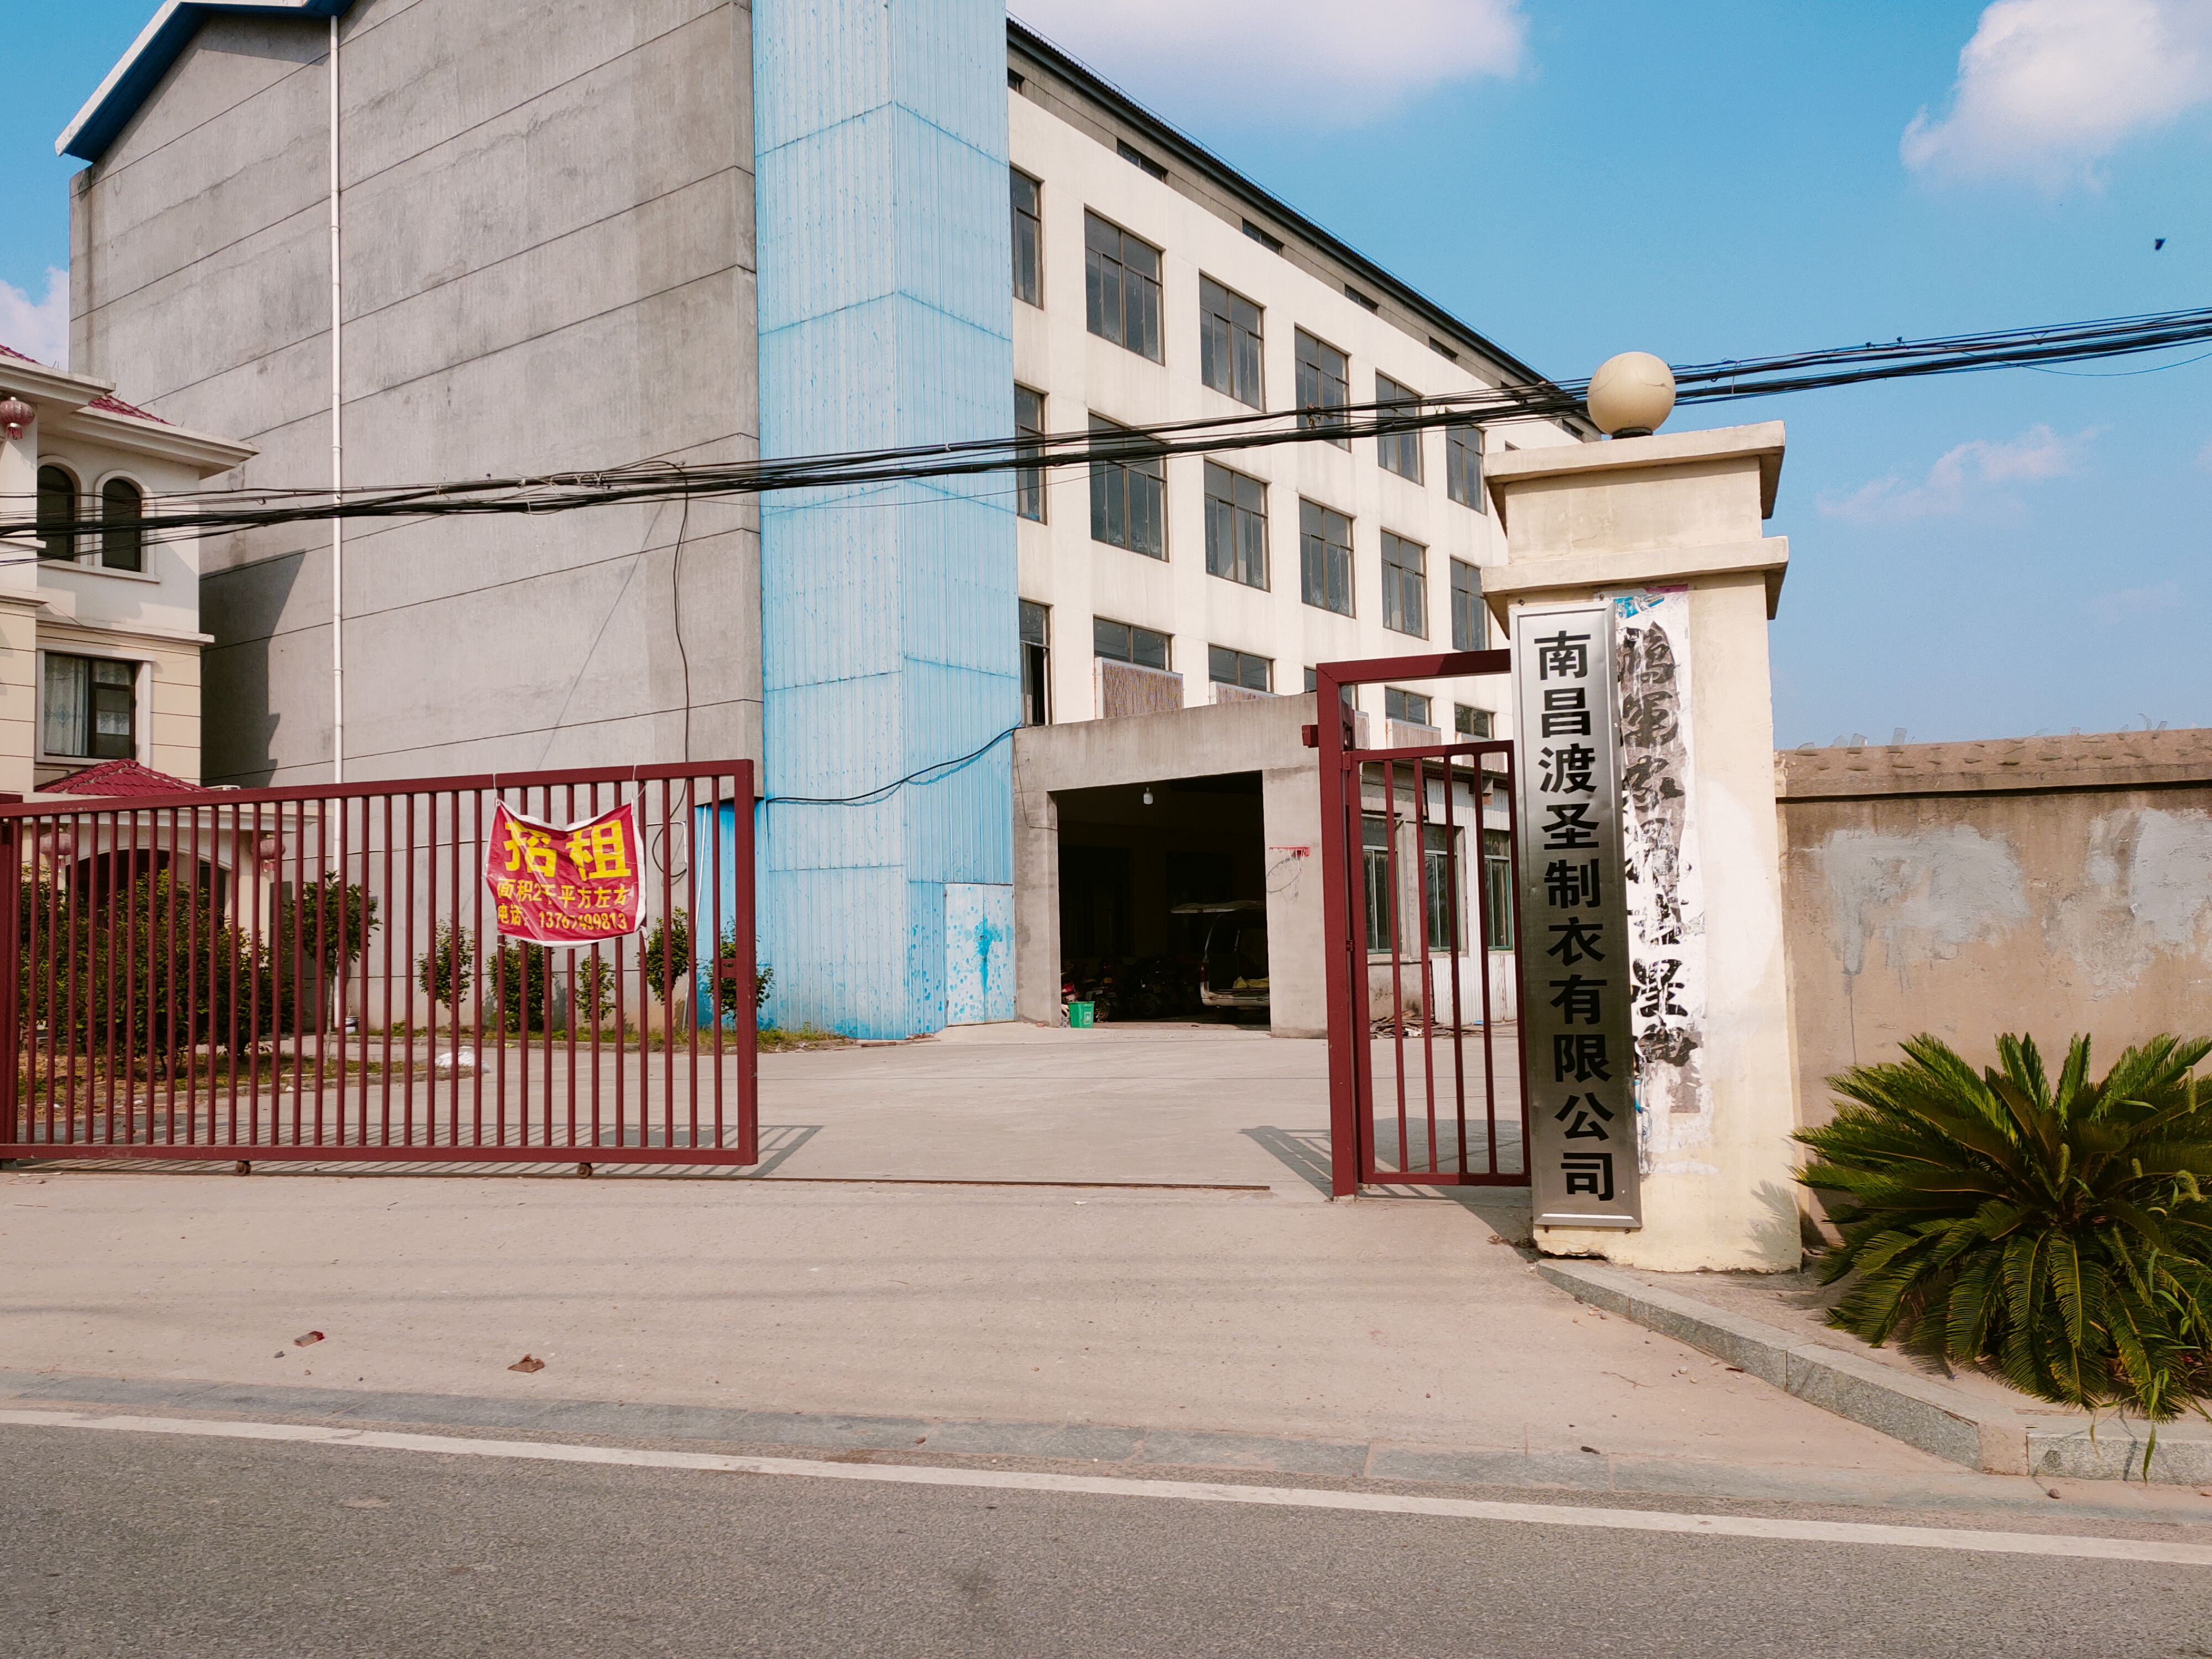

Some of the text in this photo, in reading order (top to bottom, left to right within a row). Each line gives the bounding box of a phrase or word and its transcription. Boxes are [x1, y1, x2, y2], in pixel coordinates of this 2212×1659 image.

[503, 820, 632, 881] 招租
[1534, 630, 1616, 1201] 南昌渡圣制衣有限公司
